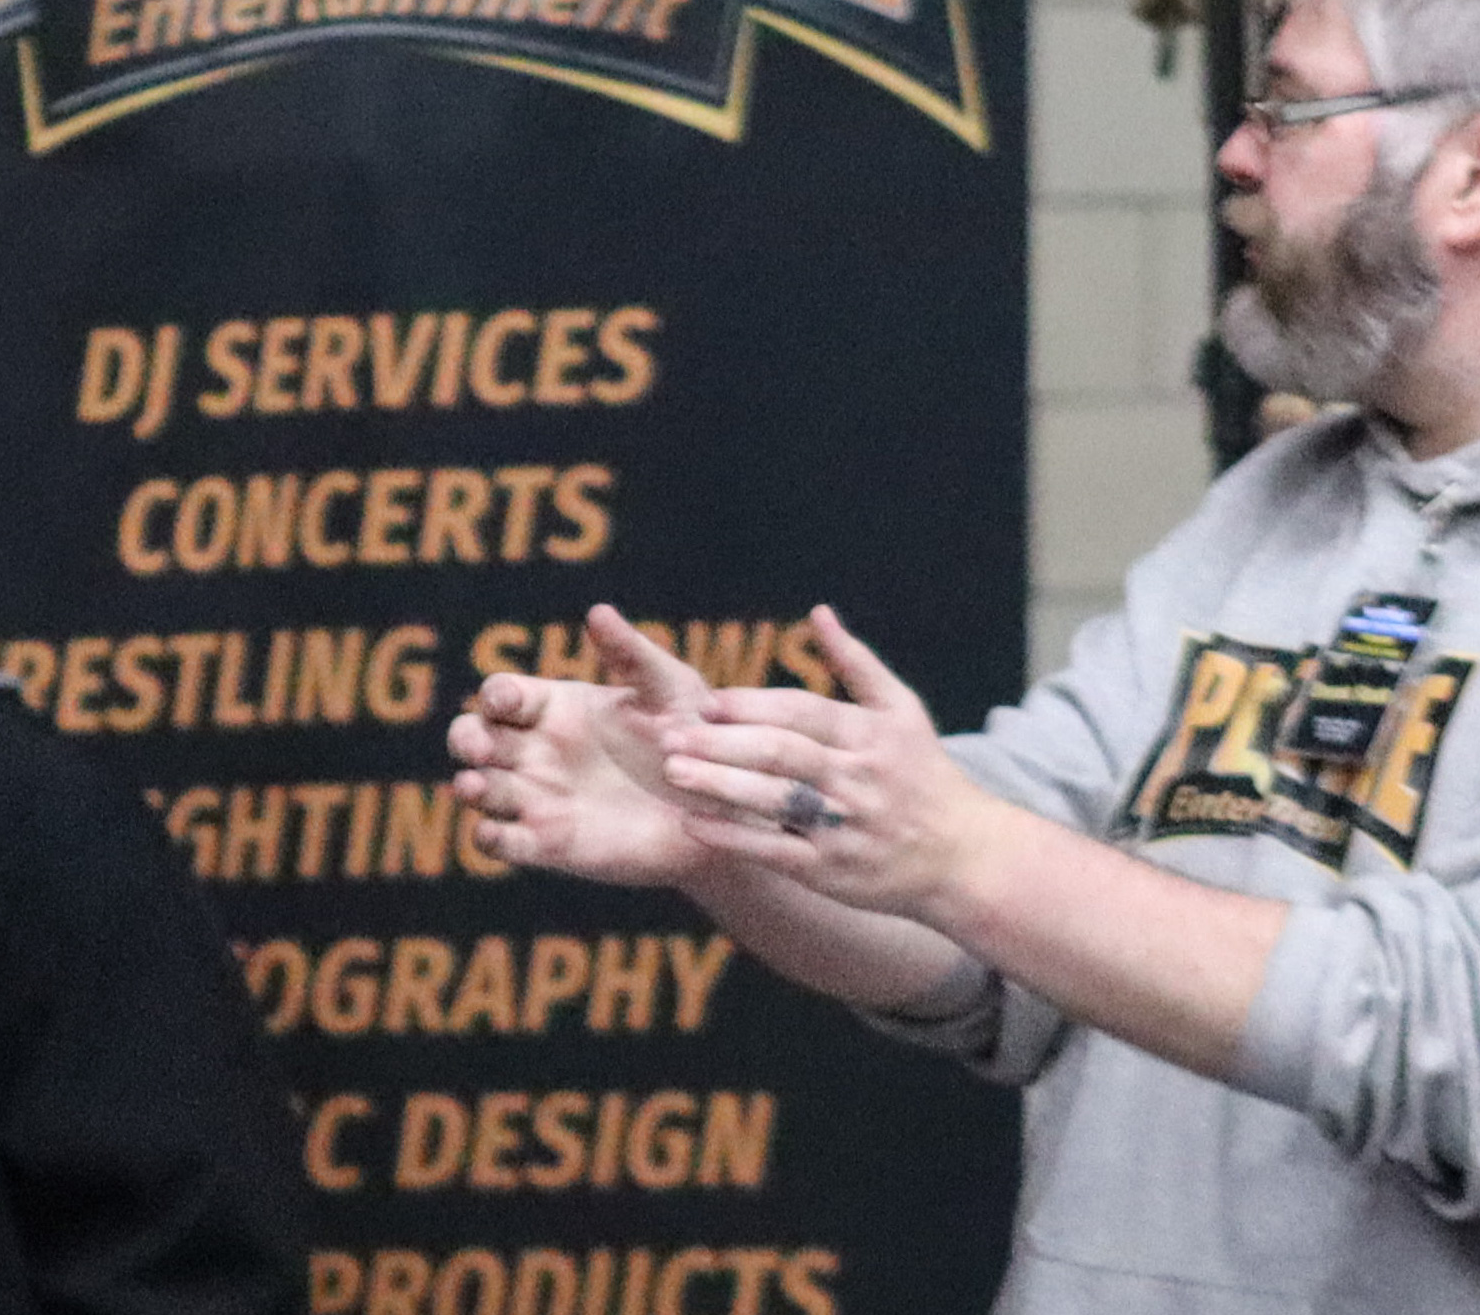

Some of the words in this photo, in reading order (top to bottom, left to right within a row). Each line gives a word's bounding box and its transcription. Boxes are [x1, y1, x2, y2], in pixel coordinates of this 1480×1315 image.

[75, 325, 185, 439] DJ
[196, 307, 660, 418] SERVICES
[116, 465, 617, 575] CONCERTS
[394, 1090, 777, 1191] DESIGN
